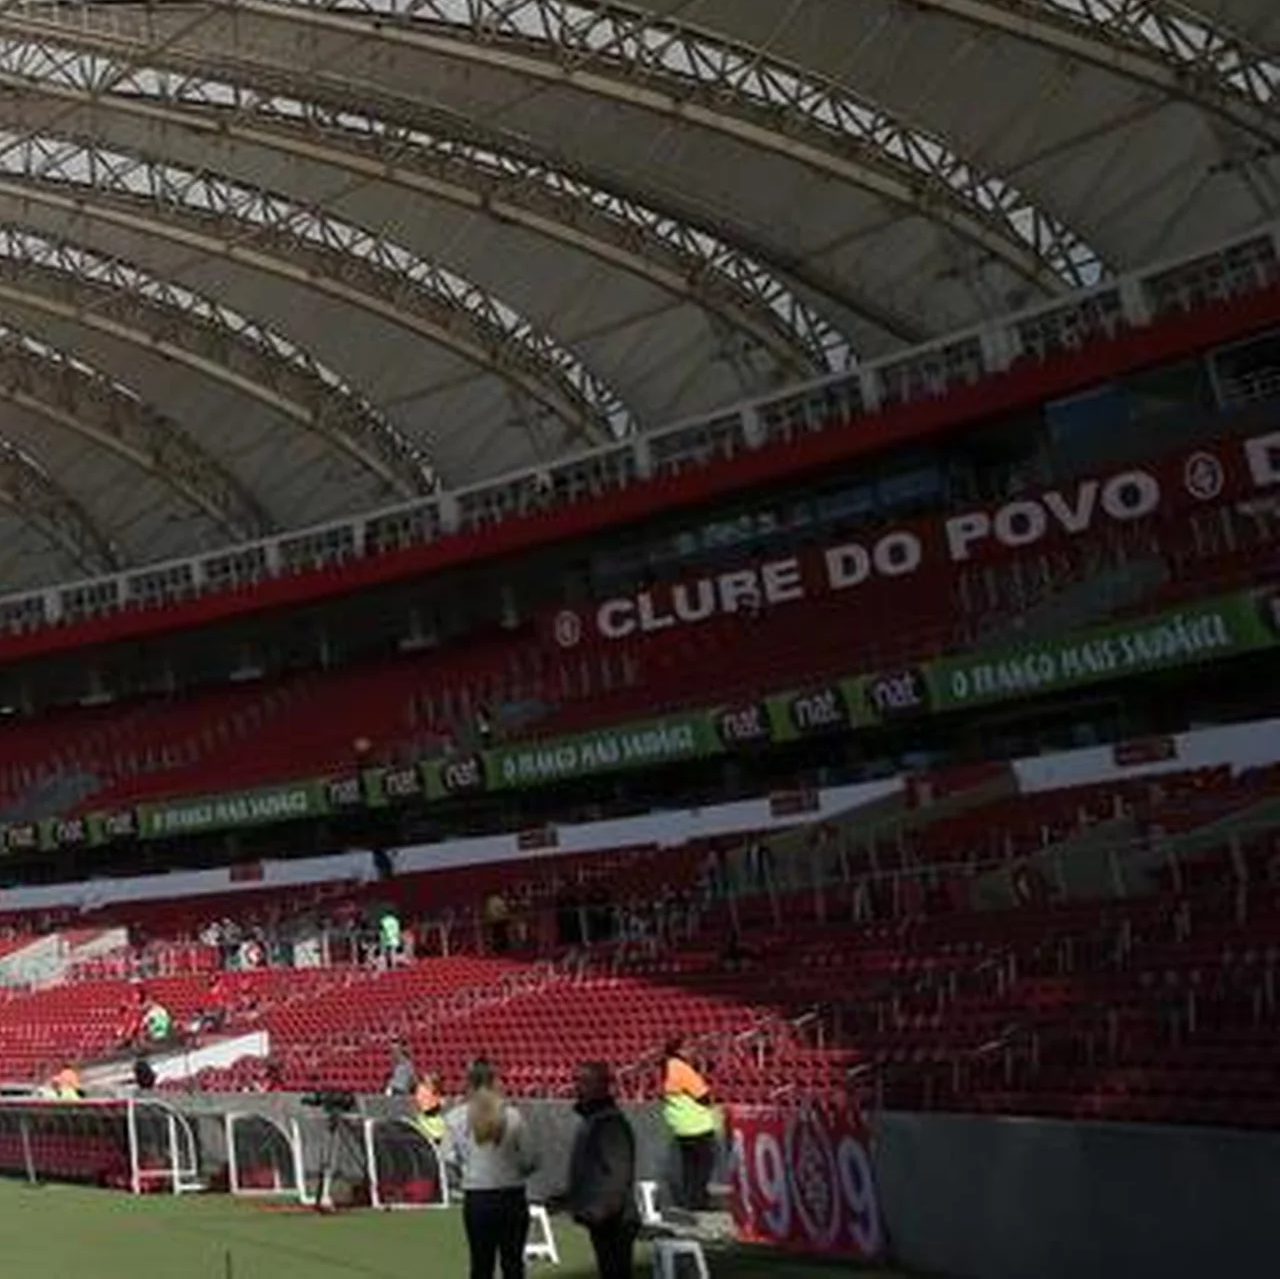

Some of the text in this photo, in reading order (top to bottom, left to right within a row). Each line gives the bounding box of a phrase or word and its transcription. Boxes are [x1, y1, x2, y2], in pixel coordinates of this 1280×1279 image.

[597, 469, 1160, 638] CLUBE DO POVO
